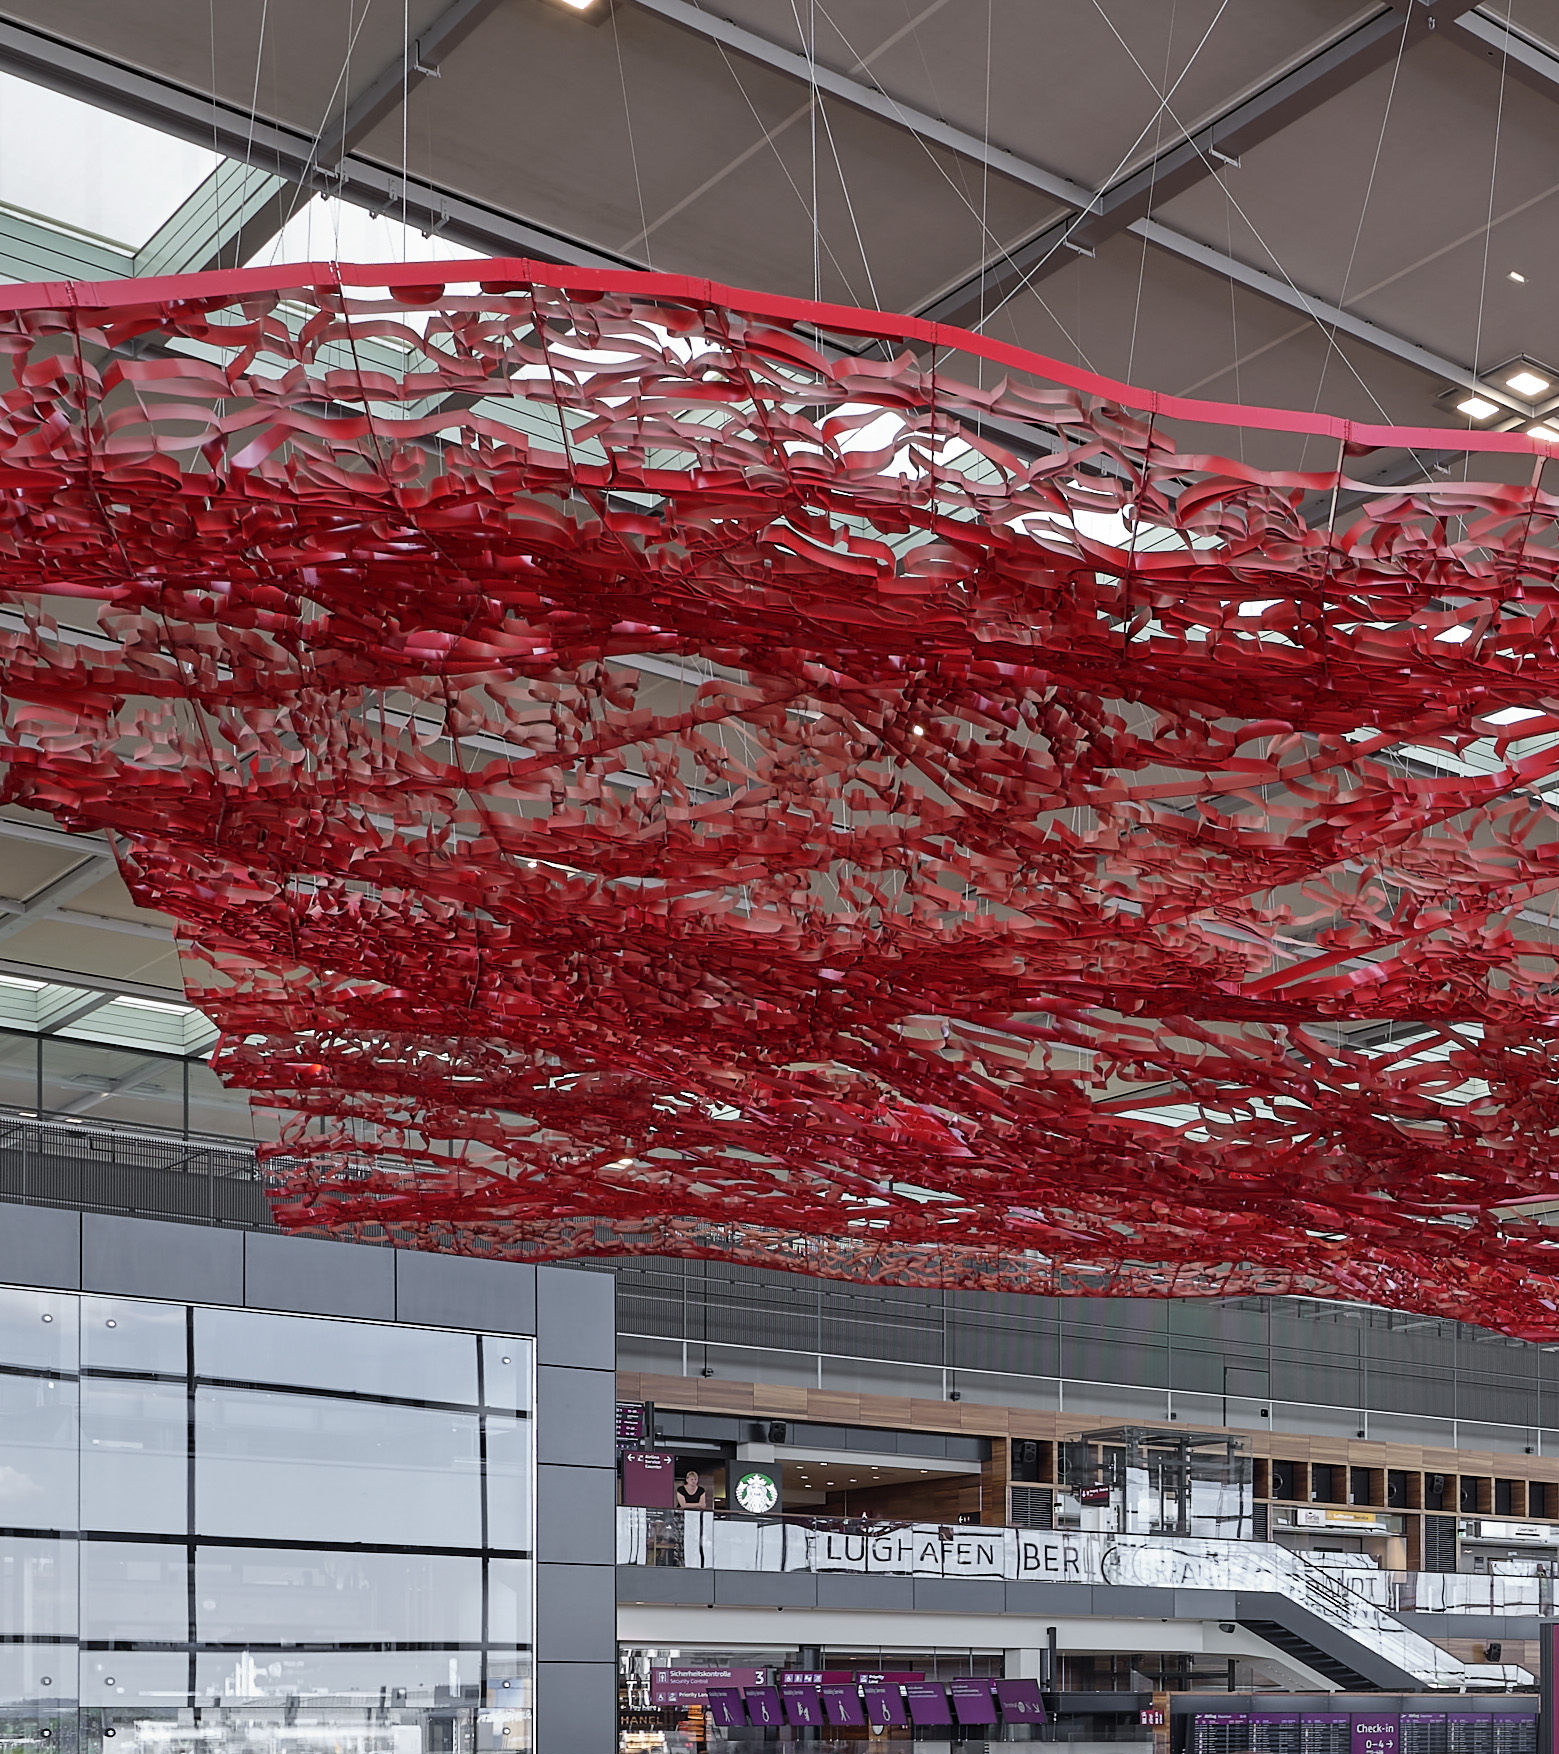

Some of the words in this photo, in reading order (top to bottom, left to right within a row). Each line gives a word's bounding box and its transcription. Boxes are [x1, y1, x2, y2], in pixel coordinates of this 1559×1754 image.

[670, 1670, 731, 1678] Sicherheitskontrolle
[755, 1671, 764, 1685] 3
[621, 1715, 664, 1725] HANEL
[1356, 1723, 1394, 1733] Check-in
